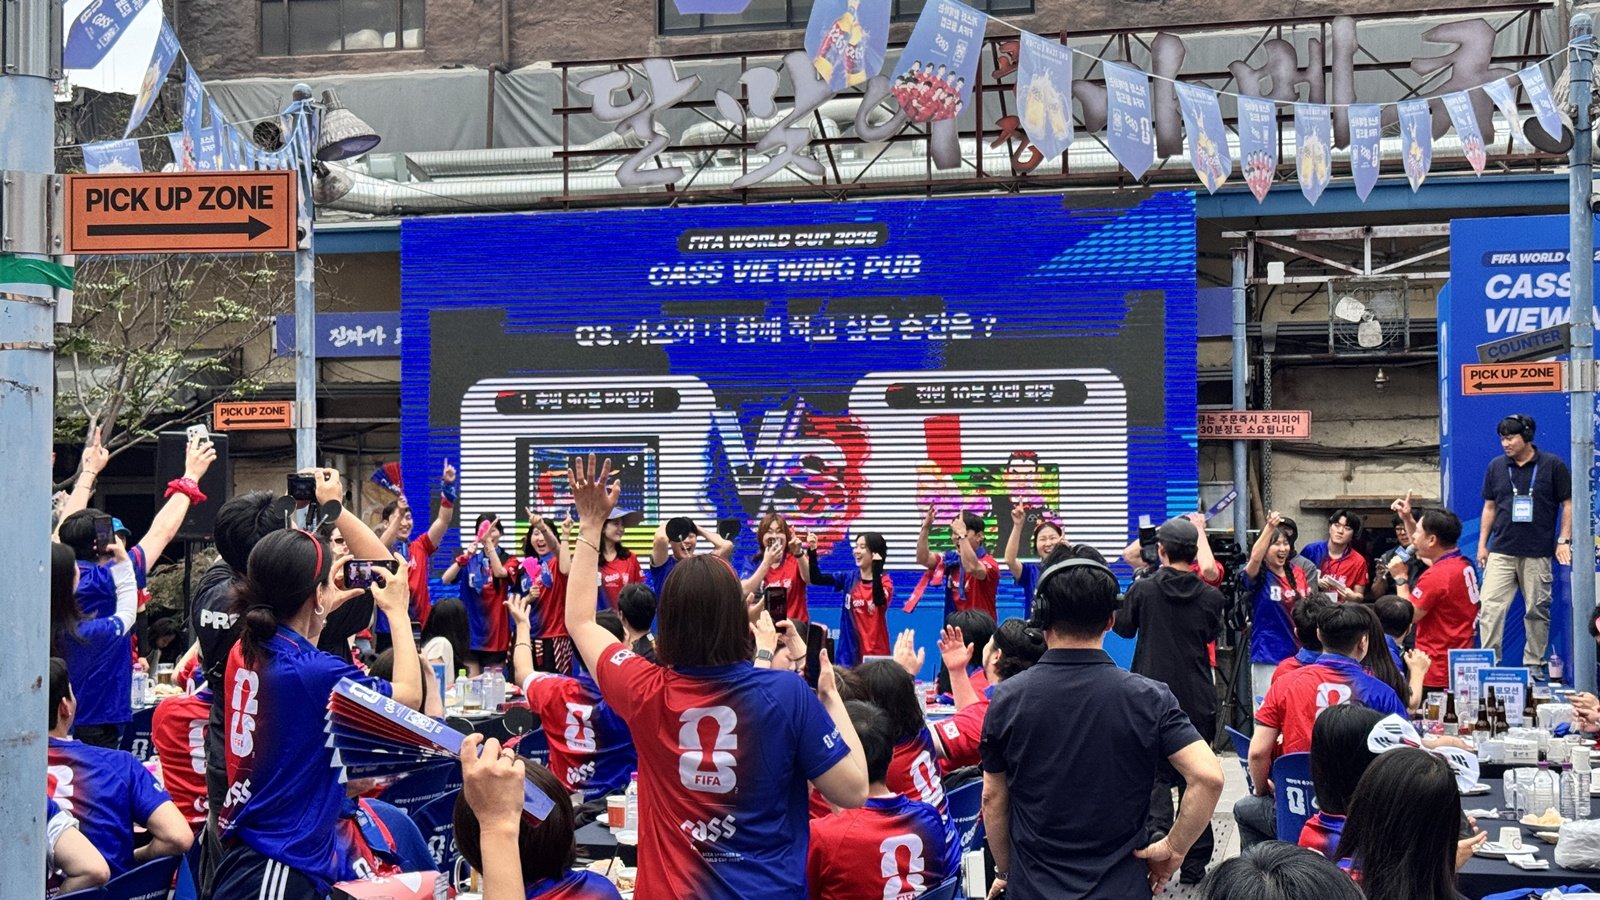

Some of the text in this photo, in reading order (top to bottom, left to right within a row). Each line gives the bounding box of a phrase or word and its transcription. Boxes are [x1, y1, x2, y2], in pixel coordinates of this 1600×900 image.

[86, 185, 273, 212] PICK UP ZONE
[689, 231, 879, 250] FIFA WORLD CUP 2026
[1491, 253, 1517, 264] FIFA
[1520, 252, 1564, 264] WORLD
[648, 254, 922, 285] CASS VIEWING PUB
[1485, 272, 1570, 299] CASS
[1488, 329, 1561, 358] COUNTER
[1470, 367, 1554, 380] PICK UP ZONE
[220, 406, 286, 417] PICK UP ZONE
[1262, 414, 1301, 424] 조리되어
[1247, 425, 1295, 435] 소요됩니다
[694, 774, 721, 787] FIFA
